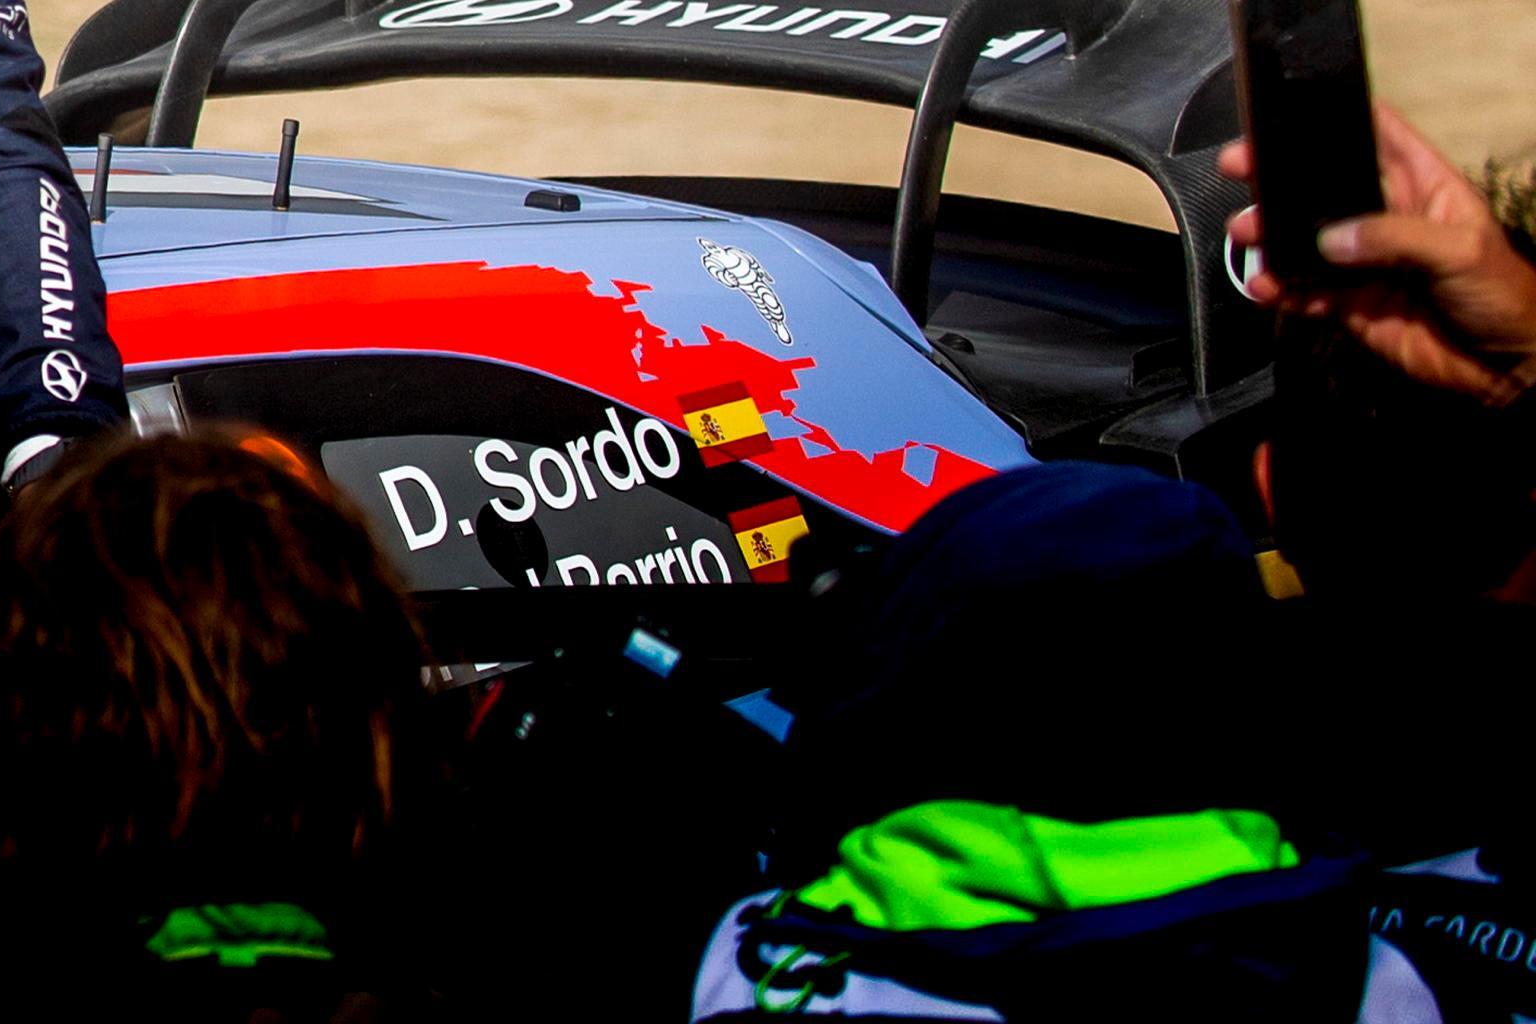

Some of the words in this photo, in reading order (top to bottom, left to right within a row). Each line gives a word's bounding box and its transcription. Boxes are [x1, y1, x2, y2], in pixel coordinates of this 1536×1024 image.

[39, 178, 76, 342] HYUNDAI
[378, 464, 474, 551] D.
[473, 407, 681, 523] Sordo
